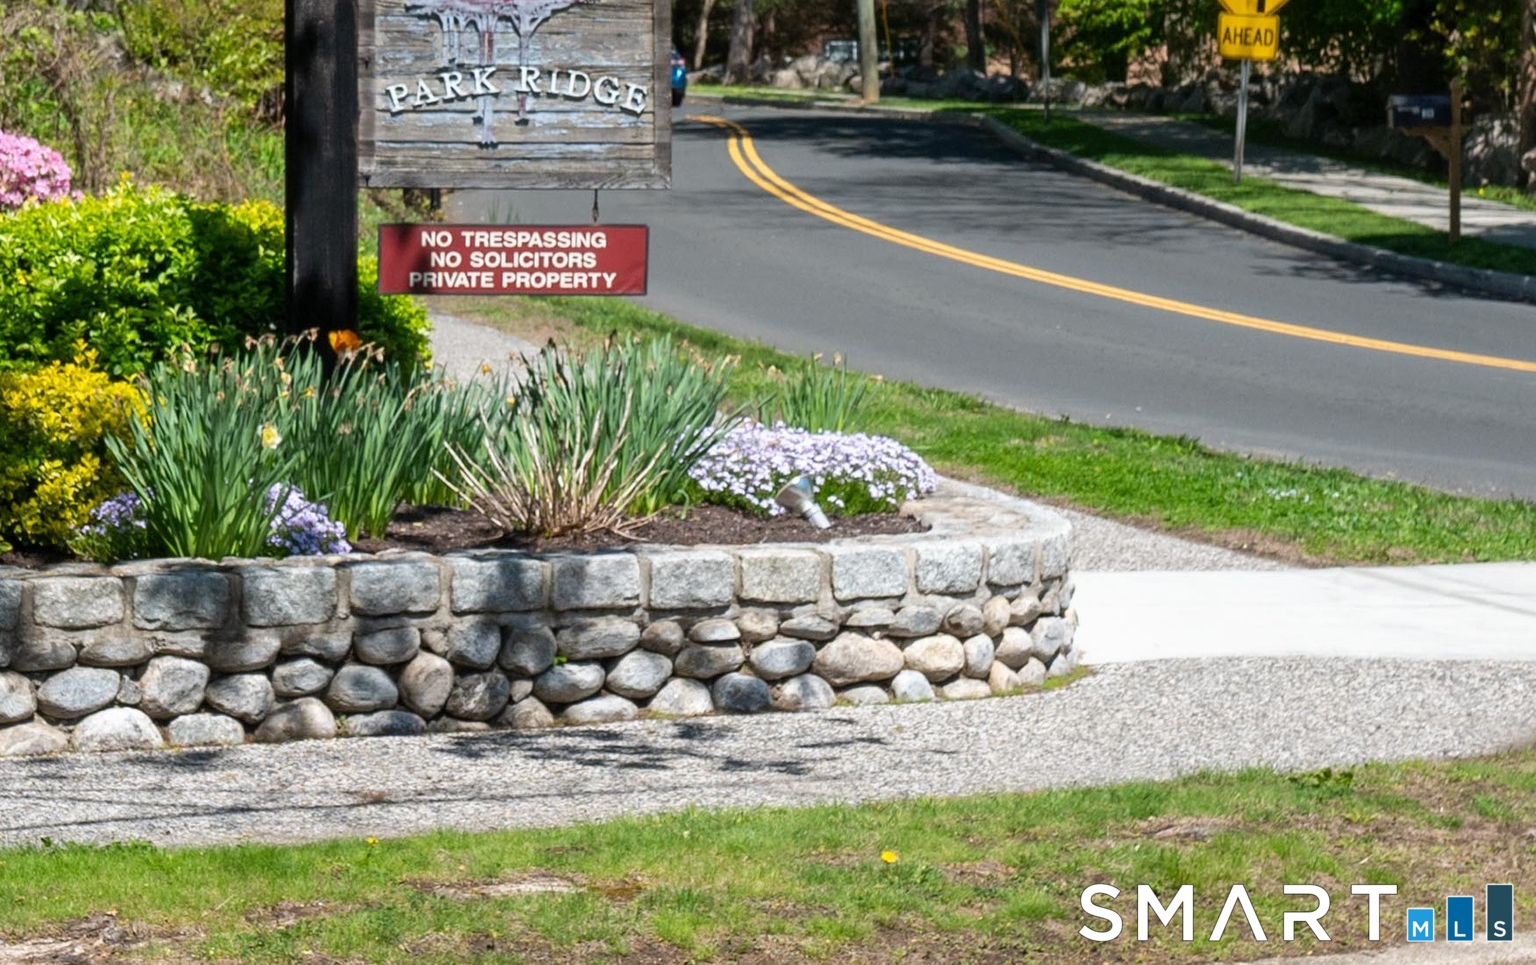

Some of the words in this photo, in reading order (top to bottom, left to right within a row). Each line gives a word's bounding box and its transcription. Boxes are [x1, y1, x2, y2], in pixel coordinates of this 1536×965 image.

[1222, 27, 1275, 47] AHEAD
[386, 66, 500, 113] PARK
[517, 66, 648, 114] RIDGE
[421, 231, 453, 248] NO
[461, 231, 607, 249] TRESPASSING
[430, 251, 462, 268] NO
[469, 251, 597, 268] SOLICITORS
[409, 271, 494, 289] PRIVATE
[502, 272, 617, 289] PROPERTY
